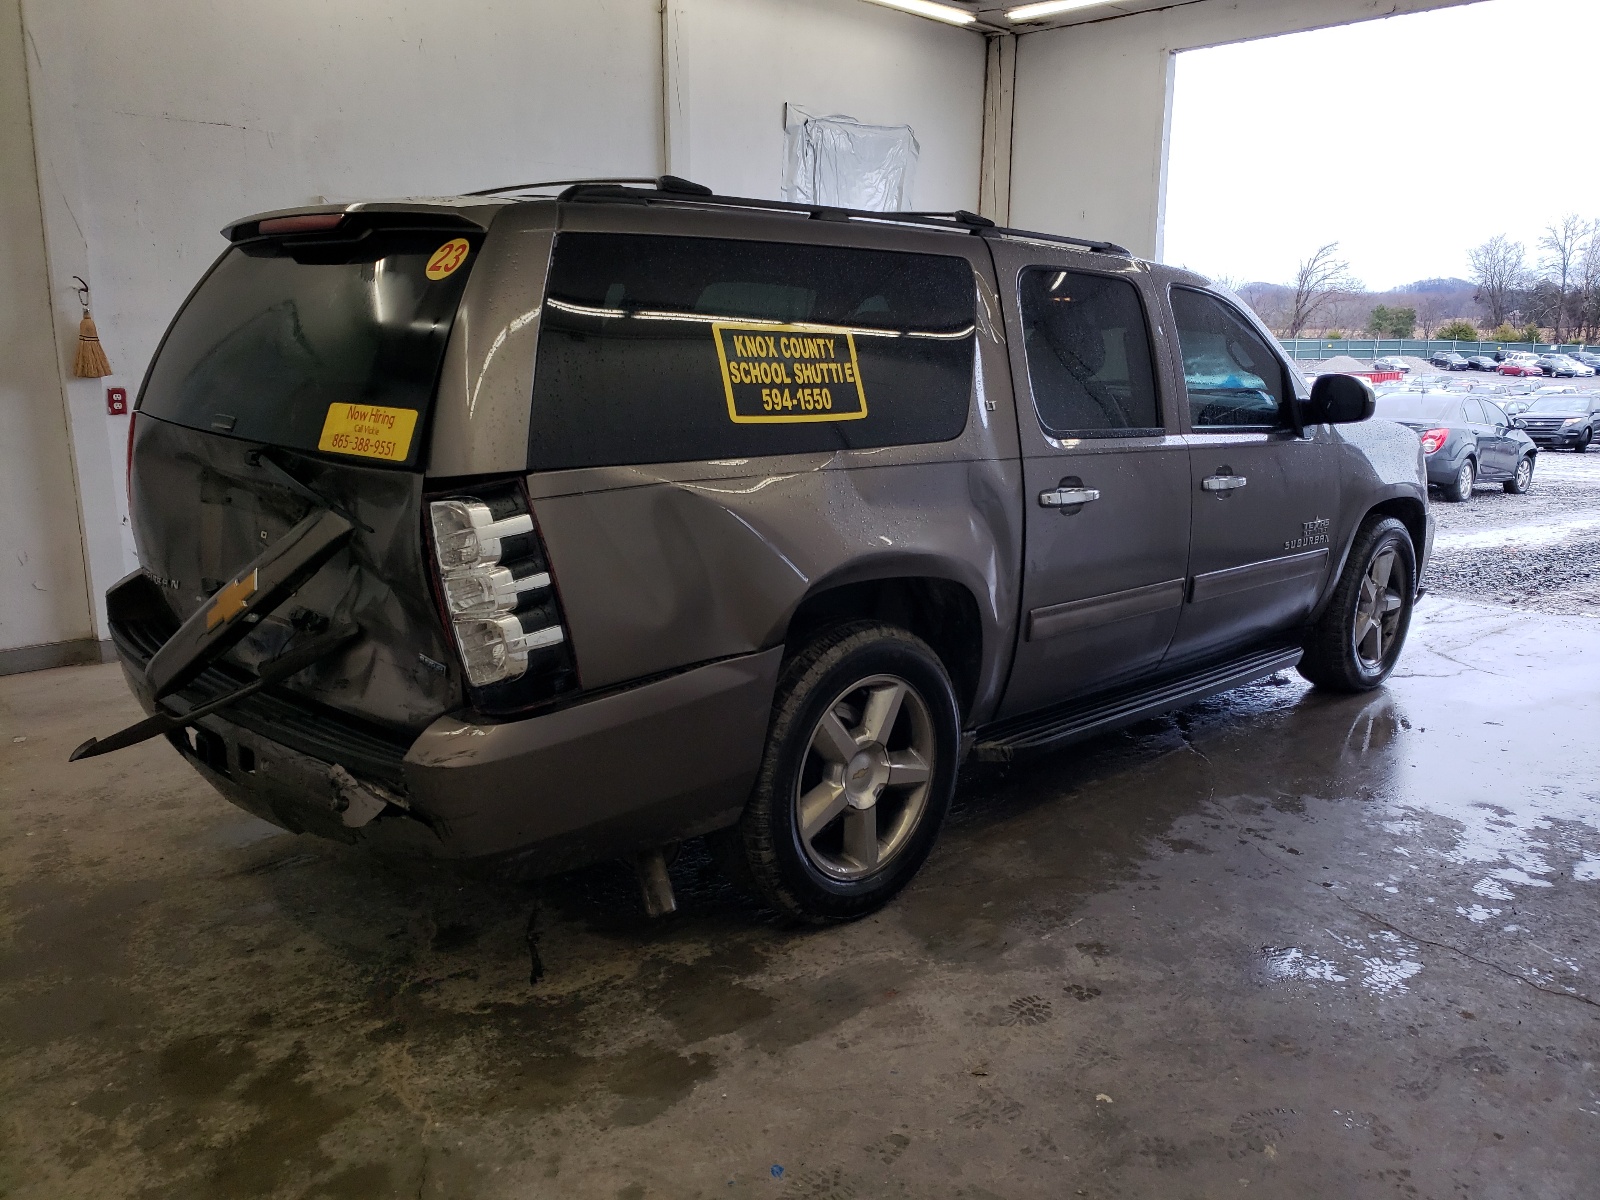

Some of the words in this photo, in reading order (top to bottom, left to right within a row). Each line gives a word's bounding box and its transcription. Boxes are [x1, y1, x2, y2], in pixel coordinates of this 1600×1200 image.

[428, 243, 467, 272] 23
[733, 335, 778, 358] KNOX
[780, 337, 834, 359] COUNTY
[730, 362, 791, 384] SCHOOL
[762, 388, 832, 411] 594-1550
[347, 405, 369, 421] Now
[369, 408, 396, 430] Hiring
[332, 433, 397, 457] 865-388-9551
[1303, 517, 1330, 530] TEXAS
[1284, 534, 1330, 550] SUBURBAN
